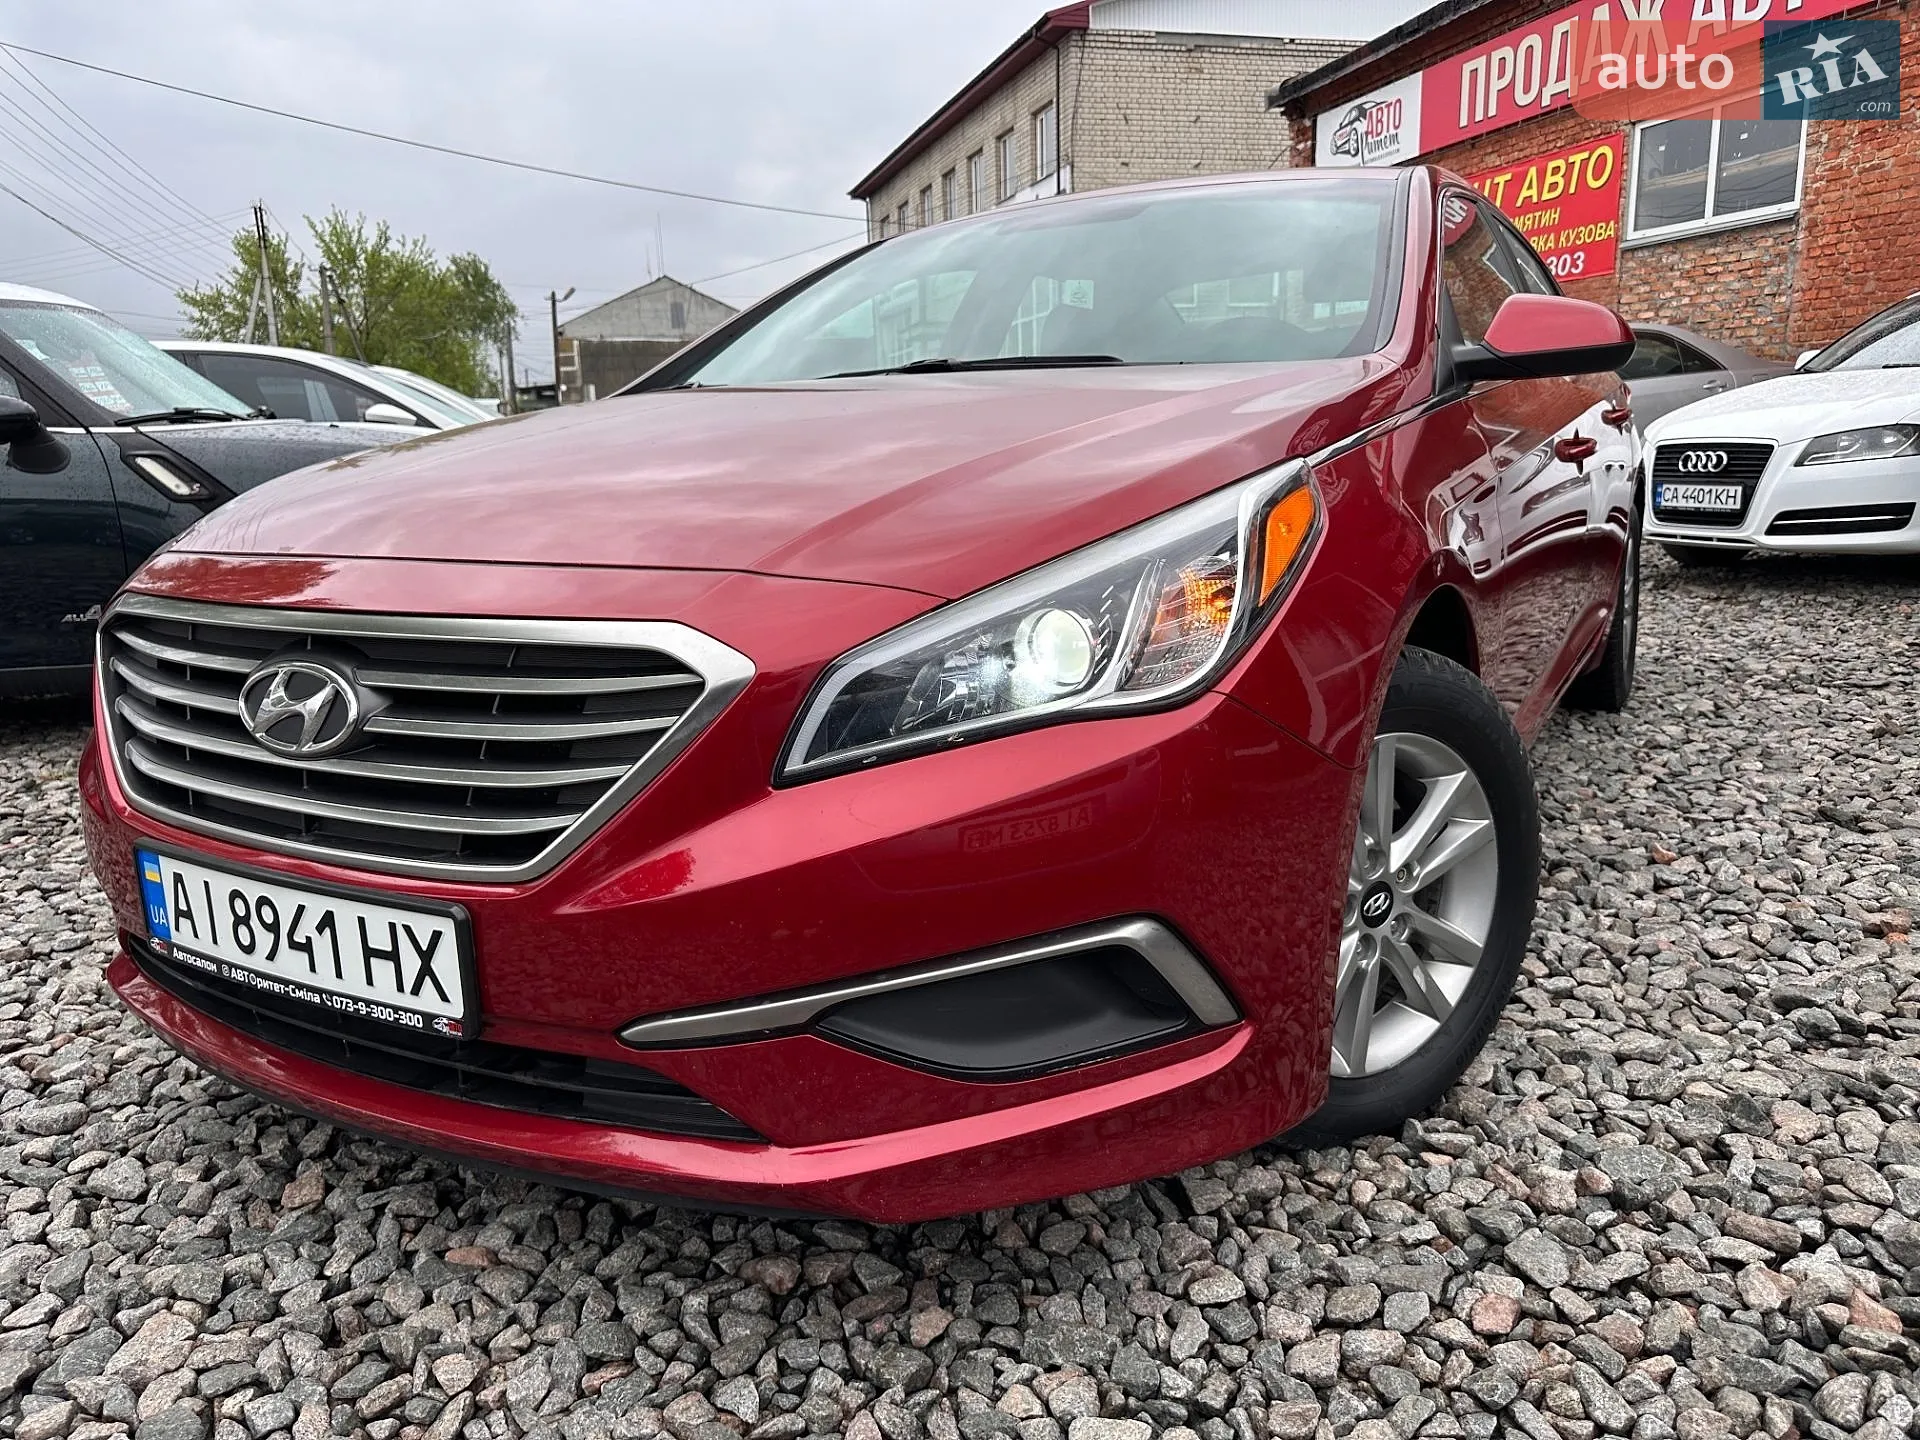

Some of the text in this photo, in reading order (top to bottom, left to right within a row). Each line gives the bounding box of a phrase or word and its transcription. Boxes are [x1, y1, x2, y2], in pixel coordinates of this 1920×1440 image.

[1459, 0, 1670, 129] ПРОДАЖ
[1365, 98, 1402, 139] АВТО
[1515, 145, 1614, 208] АВТО
[1510, 206, 1561, 232] МЯТИН
[1558, 220, 1615, 249] КУЗОВА
[1662, 487, 1679, 503] CA
[1714, 488, 1738, 506] KH
[150, 907, 168, 928] UA
[172, 871, 451, 1003] AI 8941 HX
[172, 947, 218, 973] Автосалон
[332, 995, 424, 1028] 073-9-300-300
